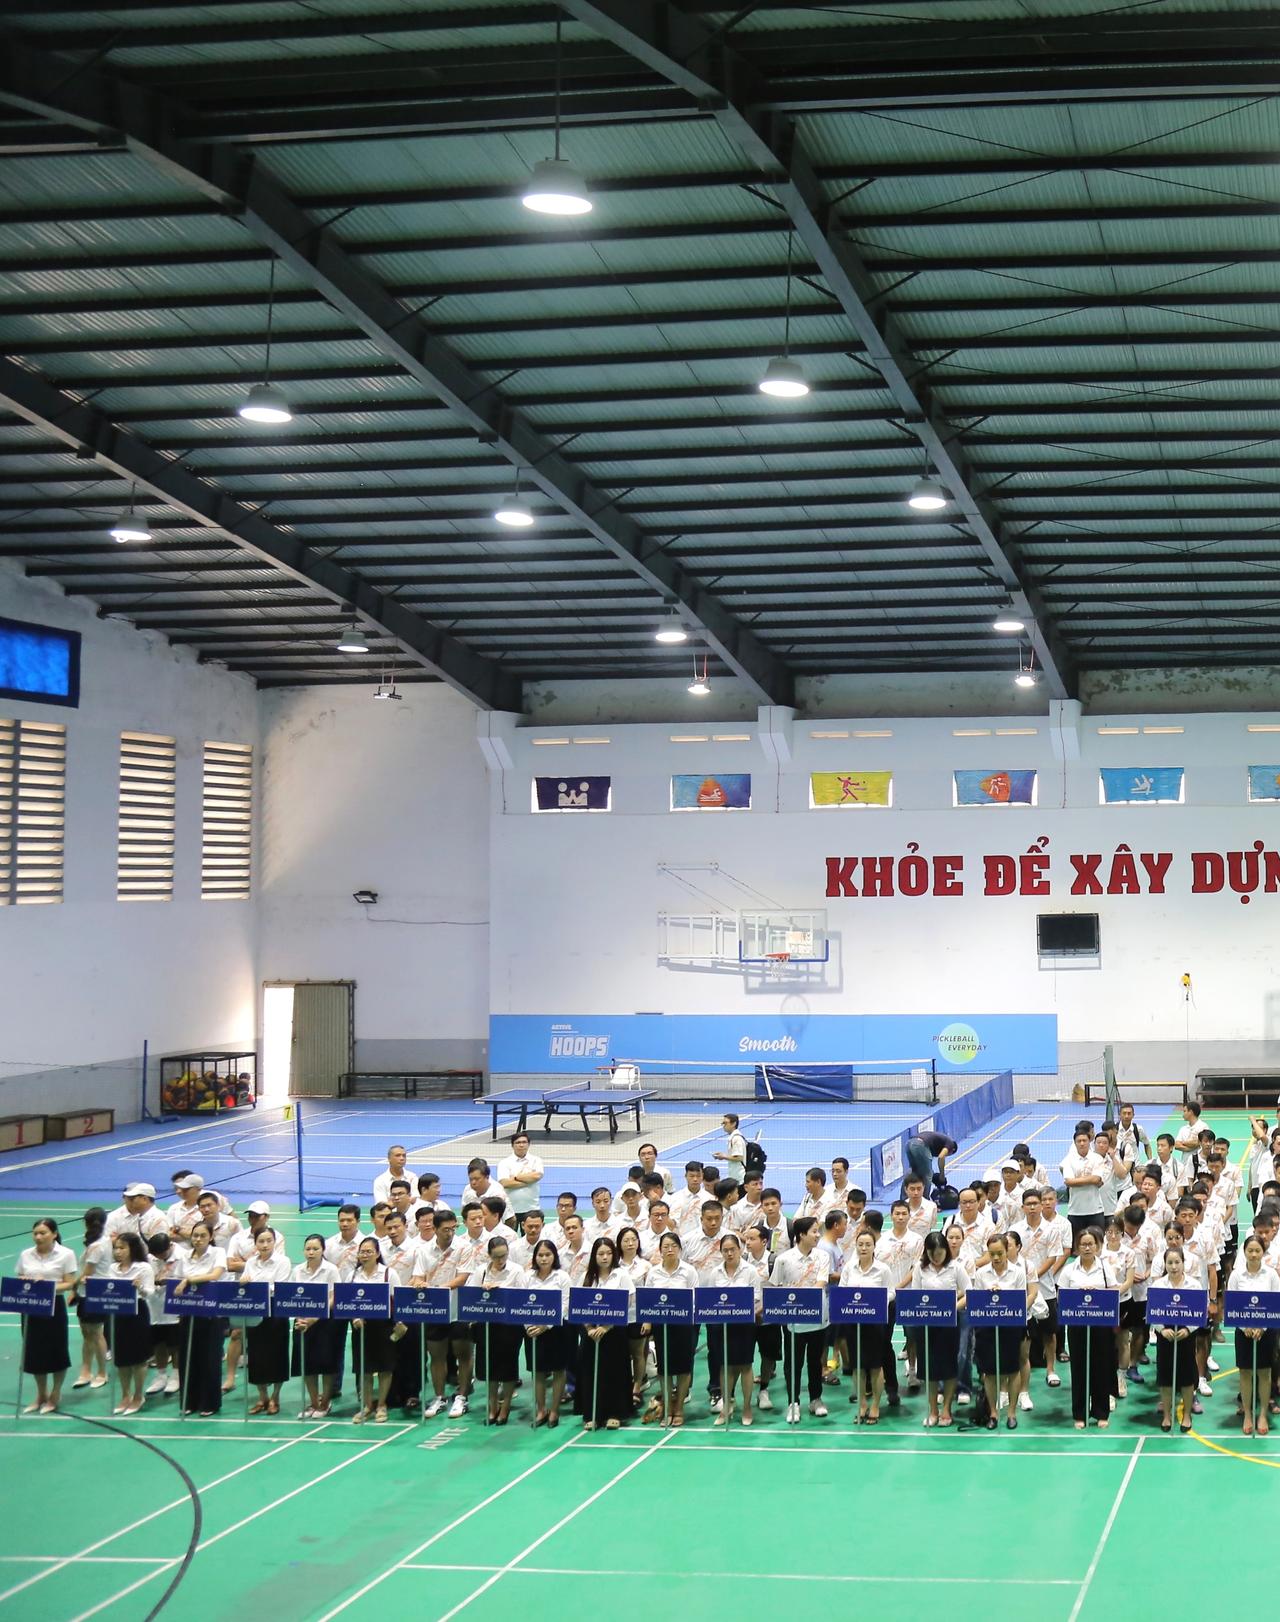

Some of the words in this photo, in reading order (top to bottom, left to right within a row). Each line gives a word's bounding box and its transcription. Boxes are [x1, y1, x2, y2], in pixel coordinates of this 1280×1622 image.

[825, 842, 963, 897] KHỎE
[983, 836, 1050, 896] ĐỂ
[1070, 843, 1173, 895] XÂY
[932, 1034, 974, 1042] PICKLEBALL
[549, 1035, 610, 1058] HOOPS
[739, 1035, 798, 1053] Smooth
[284, 1105, 291, 1119] 7
[84, 1116, 94, 1136] 2
[15, 1121, 25, 1146] 1
[532, 1308, 546, 1316] ĐIỀU
[547, 1309, 557, 1317] ĐỘ
[670, 1309, 689, 1317] THUẬT
[788, 1307, 797, 1315] KẾ
[900, 1309, 915, 1317] ĐIỆN
[970, 1309, 985, 1318] ĐIỆN
[1000, 1308, 1014, 1317] CẨM
[1014, 1309, 1023, 1318] LỆ
[1061, 1309, 1074, 1317] ĐIỆN
[1075, 1310, 1086, 1318] LỰC
[1150, 1309, 1165, 1317] ĐIỆN
[1227, 1310, 1240, 1319] ĐIỆN
[1251, 1311, 1266, 1319] ĐÔNG
